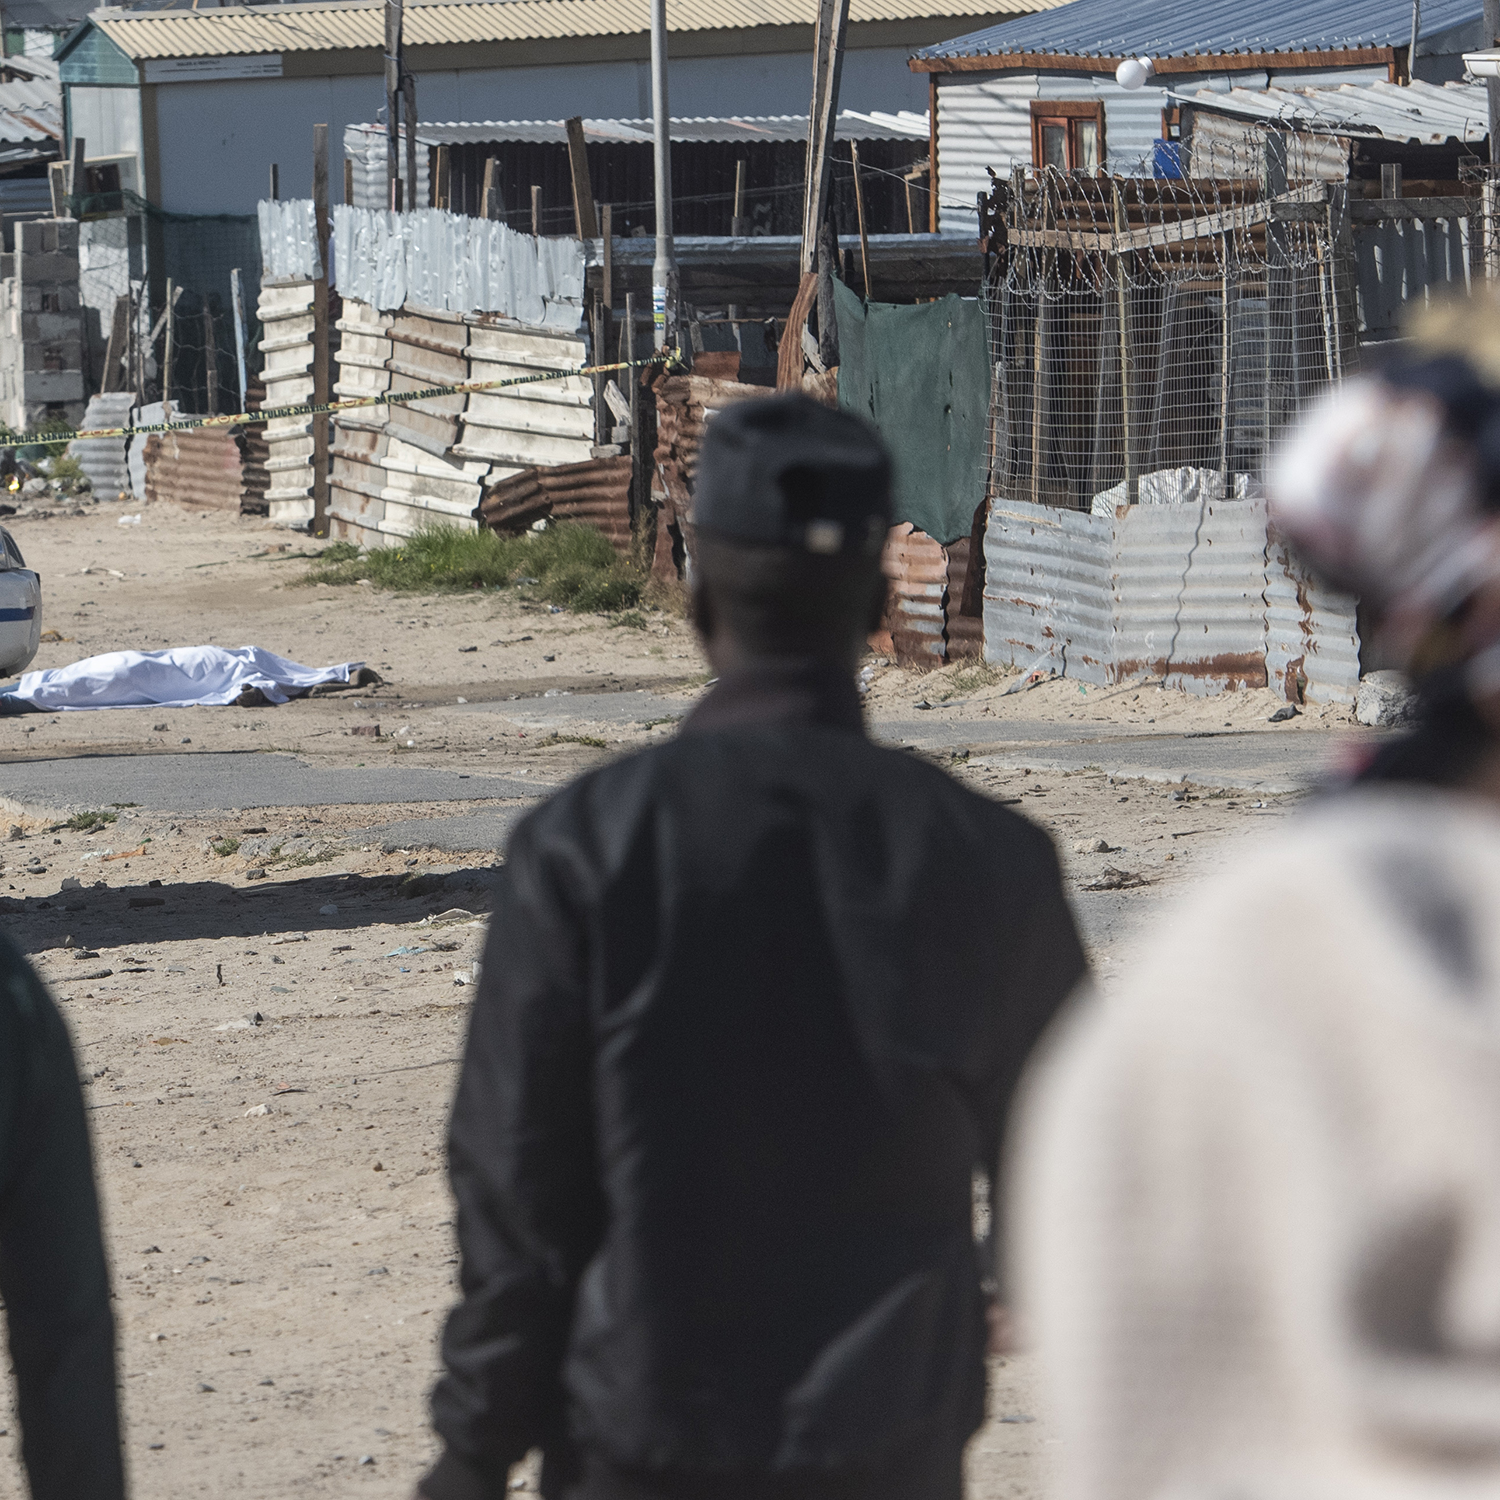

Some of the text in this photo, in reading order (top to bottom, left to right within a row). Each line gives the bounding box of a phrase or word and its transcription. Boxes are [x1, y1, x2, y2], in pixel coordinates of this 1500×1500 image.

[249, 403, 331, 420] SA POLICE SERVICE
[122, 419, 203, 434] SA POLICE SERVICE
[9, 434, 40, 444] POLICE
[41, 431, 78, 442] SERVICE
